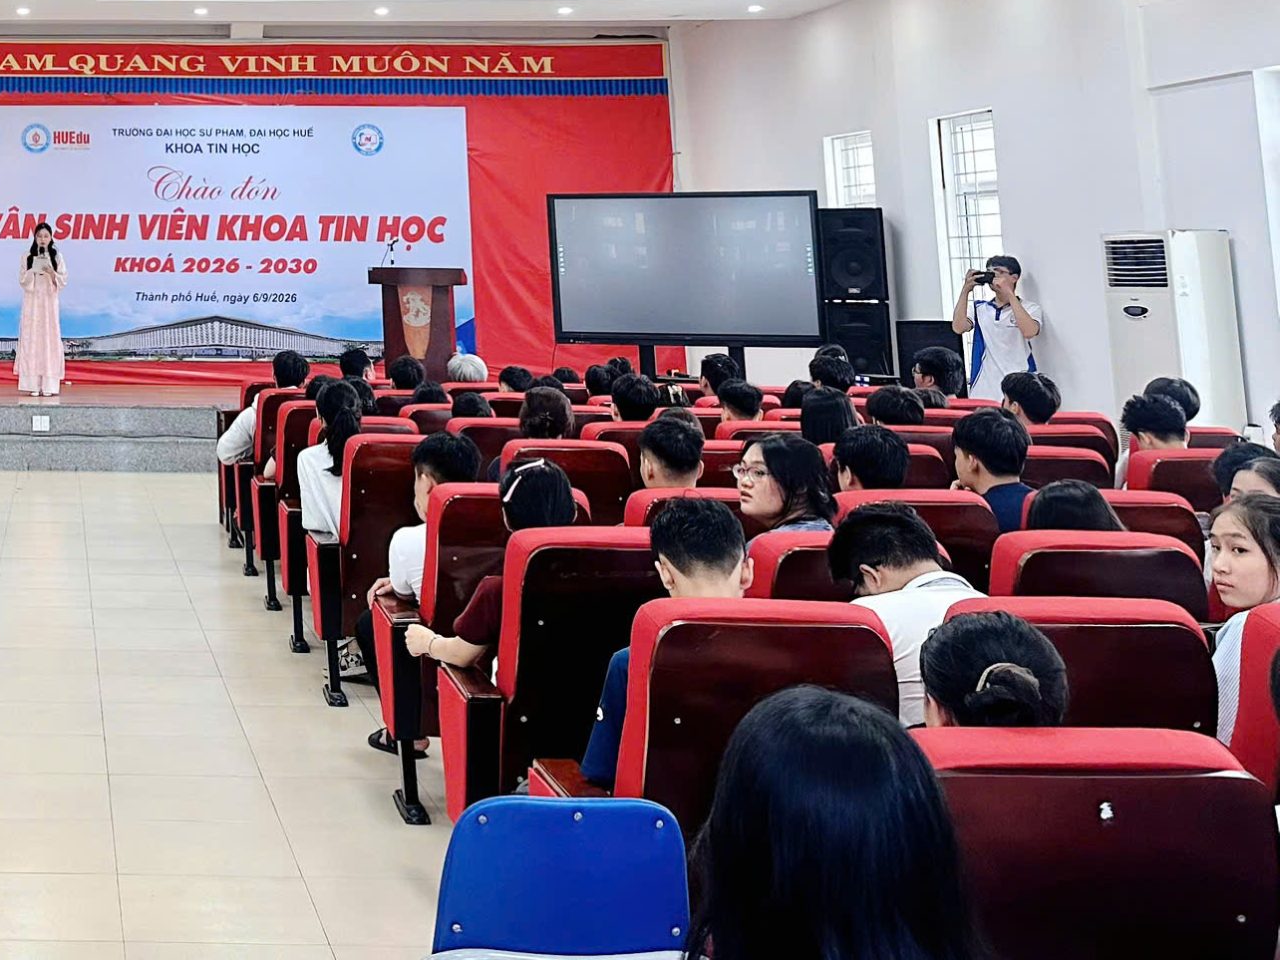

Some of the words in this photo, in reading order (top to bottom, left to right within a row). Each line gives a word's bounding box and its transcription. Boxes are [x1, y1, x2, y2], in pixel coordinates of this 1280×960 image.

[69, 53, 207, 75] QUANG
[218, 55, 318, 73] VINH
[330, 51, 450, 73] MUÔN
[462, 52, 556, 74] NĂM
[52, 131, 90, 145] HUEdu
[175, 128, 196, 139] HỌC
[199, 127, 213, 137] SƯ
[249, 128, 266, 139] ĐẠI
[269, 128, 290, 139] HỌC
[292, 126, 314, 138] HUẾ
[165, 143, 204, 154] KHOA
[207, 143, 228, 154] TIN
[231, 143, 260, 157] HỌC
[147, 165, 223, 202] Chào
[230, 175, 281, 200] đón
[53, 213, 130, 240] SINH
[138, 207, 210, 241] VIÊN
[216, 214, 309, 242] KHOA
[318, 215, 370, 243] TIN
[376, 215, 447, 251] HỌC
[114, 253, 175, 273] KHOÁ
[181, 257, 240, 274] 2026
[258, 258, 318, 274] 2030
[135, 292, 169, 302] Thành
[170, 291, 193, 304] phố
[195, 292, 219, 303] Huế,
[222, 293, 250, 304] ngày
[252, 292, 297, 303] 6/9/2026
